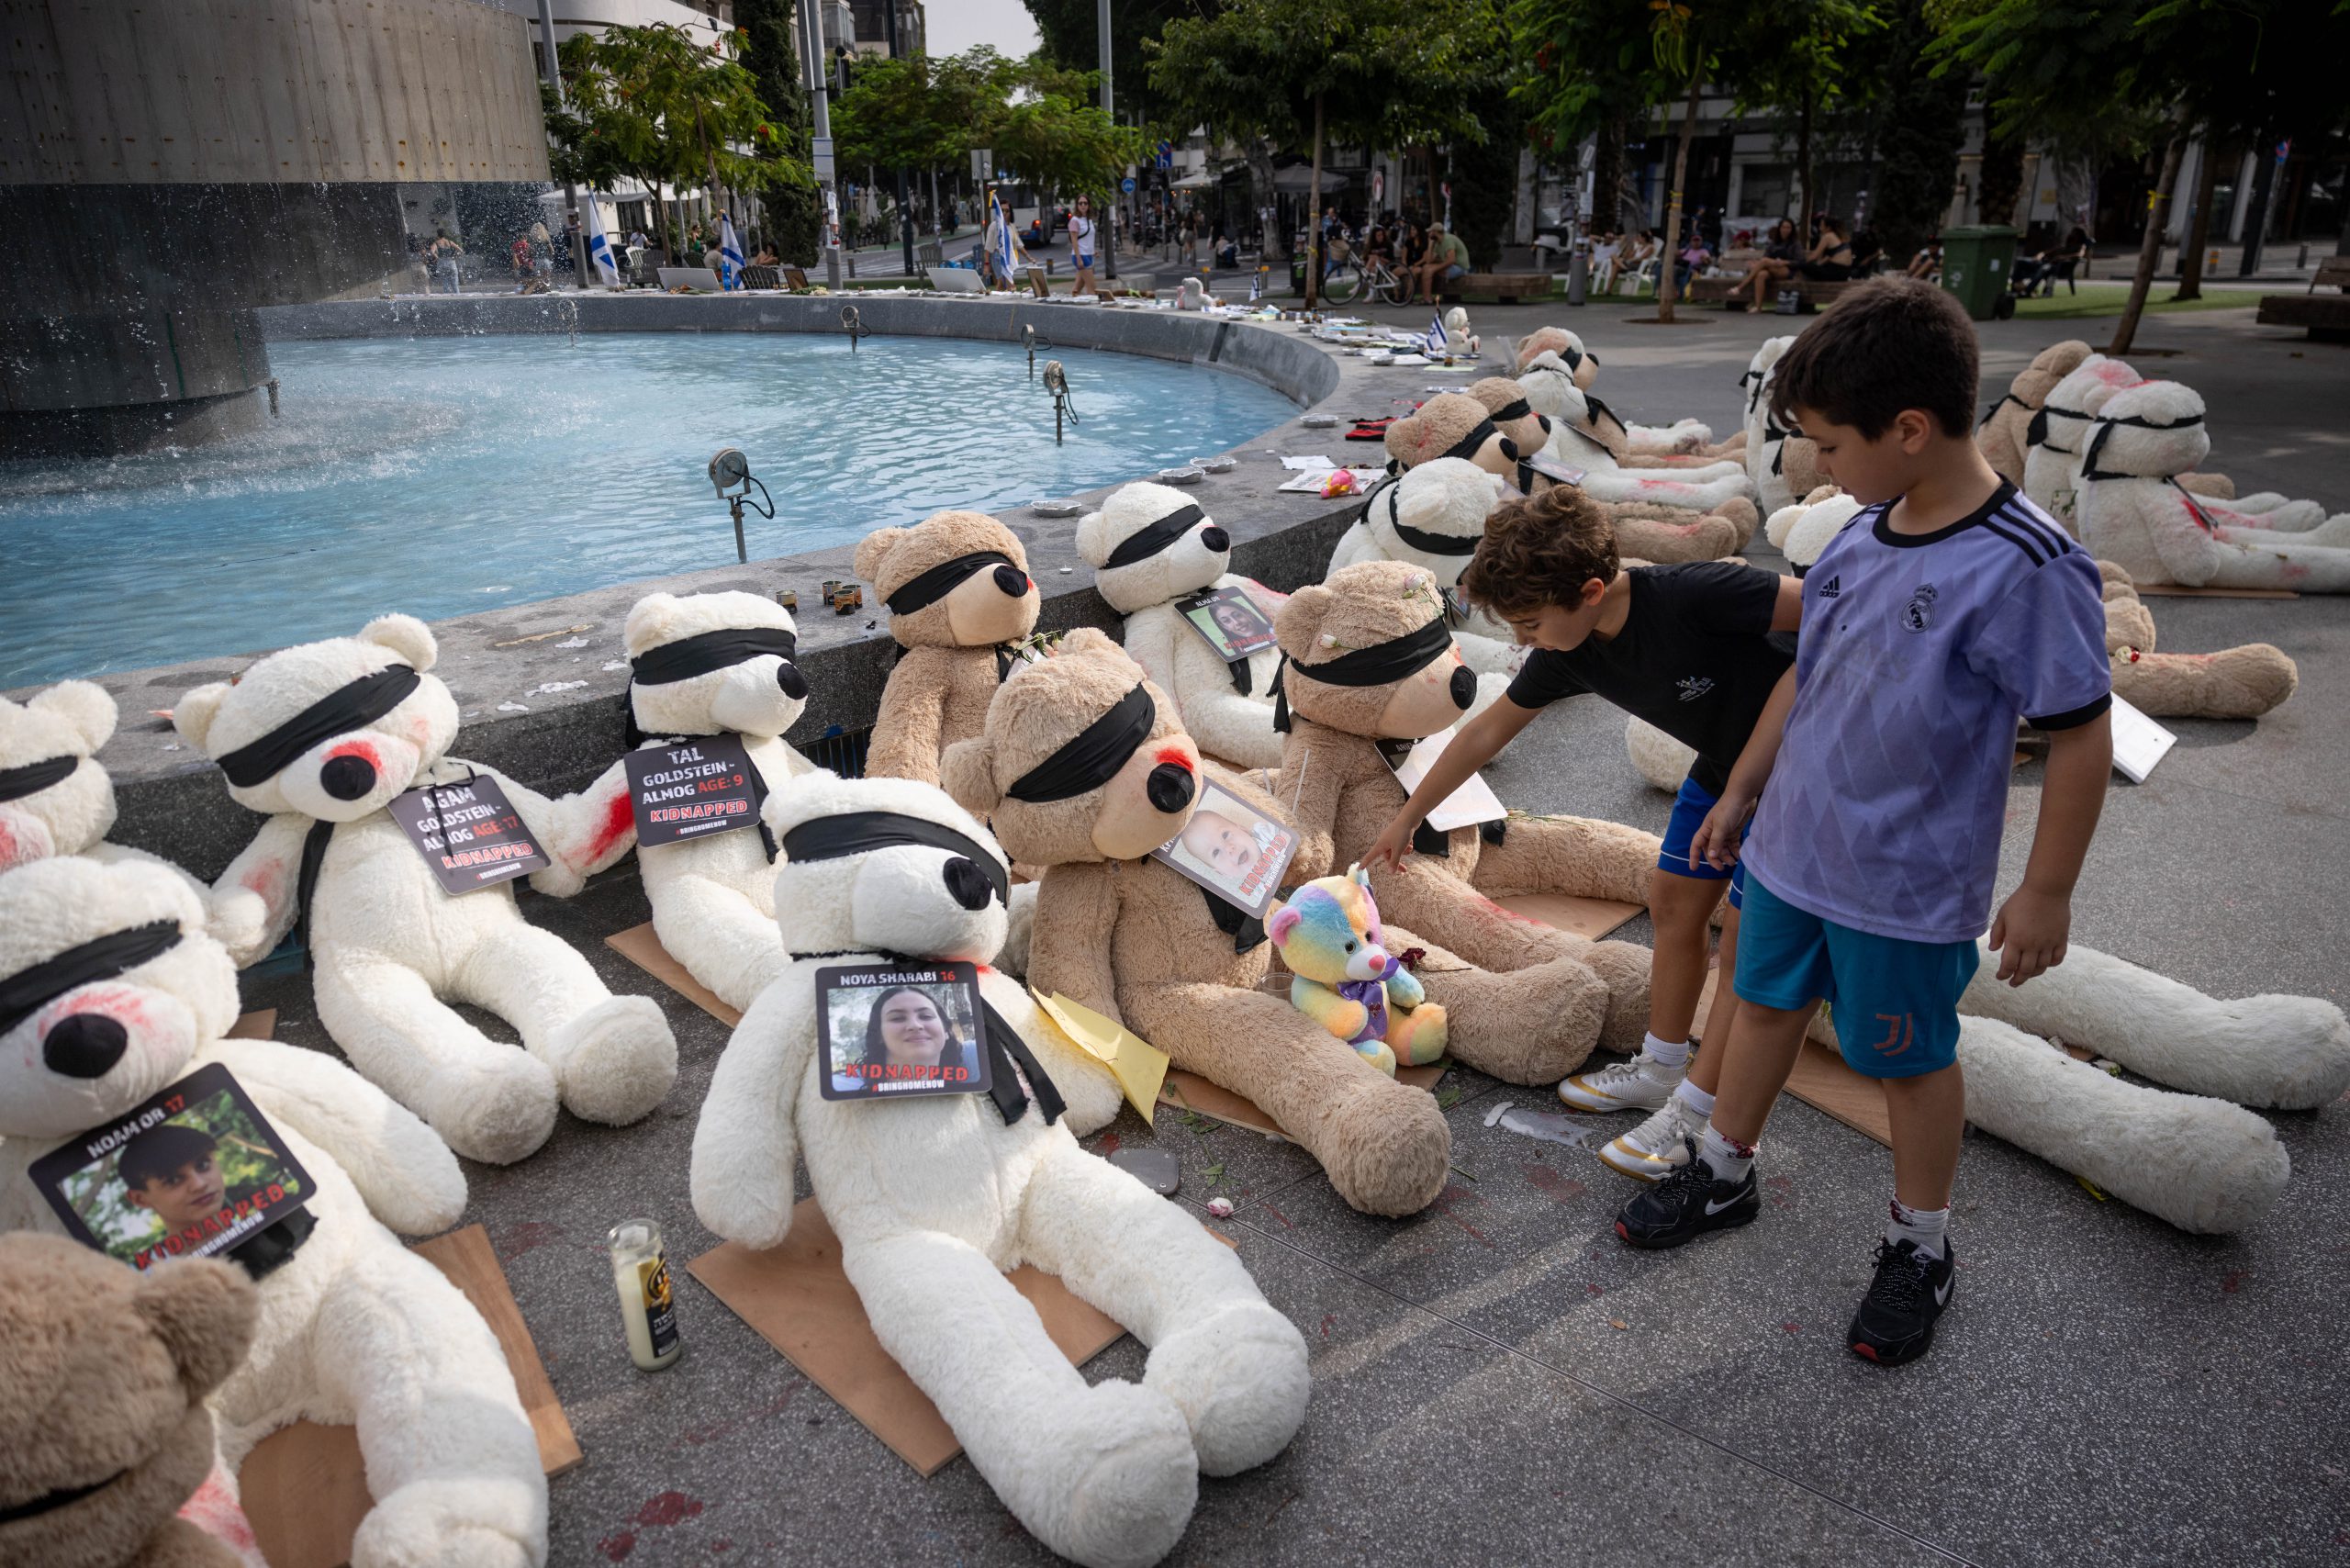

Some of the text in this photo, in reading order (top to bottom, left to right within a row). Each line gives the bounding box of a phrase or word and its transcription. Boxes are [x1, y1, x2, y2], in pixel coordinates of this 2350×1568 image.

[667, 746, 704, 765] TAL
[643, 761, 727, 787] GOLDSTEIN
[422, 787, 476, 812] AGAM
[643, 774, 744, 804] ALMOG AGE: 9
[650, 801, 748, 823] KIDNAPPED
[441, 842, 534, 869] KIDNAPPED
[1238, 835, 1287, 896] KIDNAPPED
[840, 970, 956, 986] NOYA SHARABI 16
[845, 1063, 969, 1081] KIDNAPPED
[871, 1080, 945, 1092] #BRINGHOMENOW
[86, 1094, 186, 1159] NOAM OR 17
[134, 1183, 285, 1271] KIDNAPPED
[186, 1210, 264, 1259] INGHOMENOW
